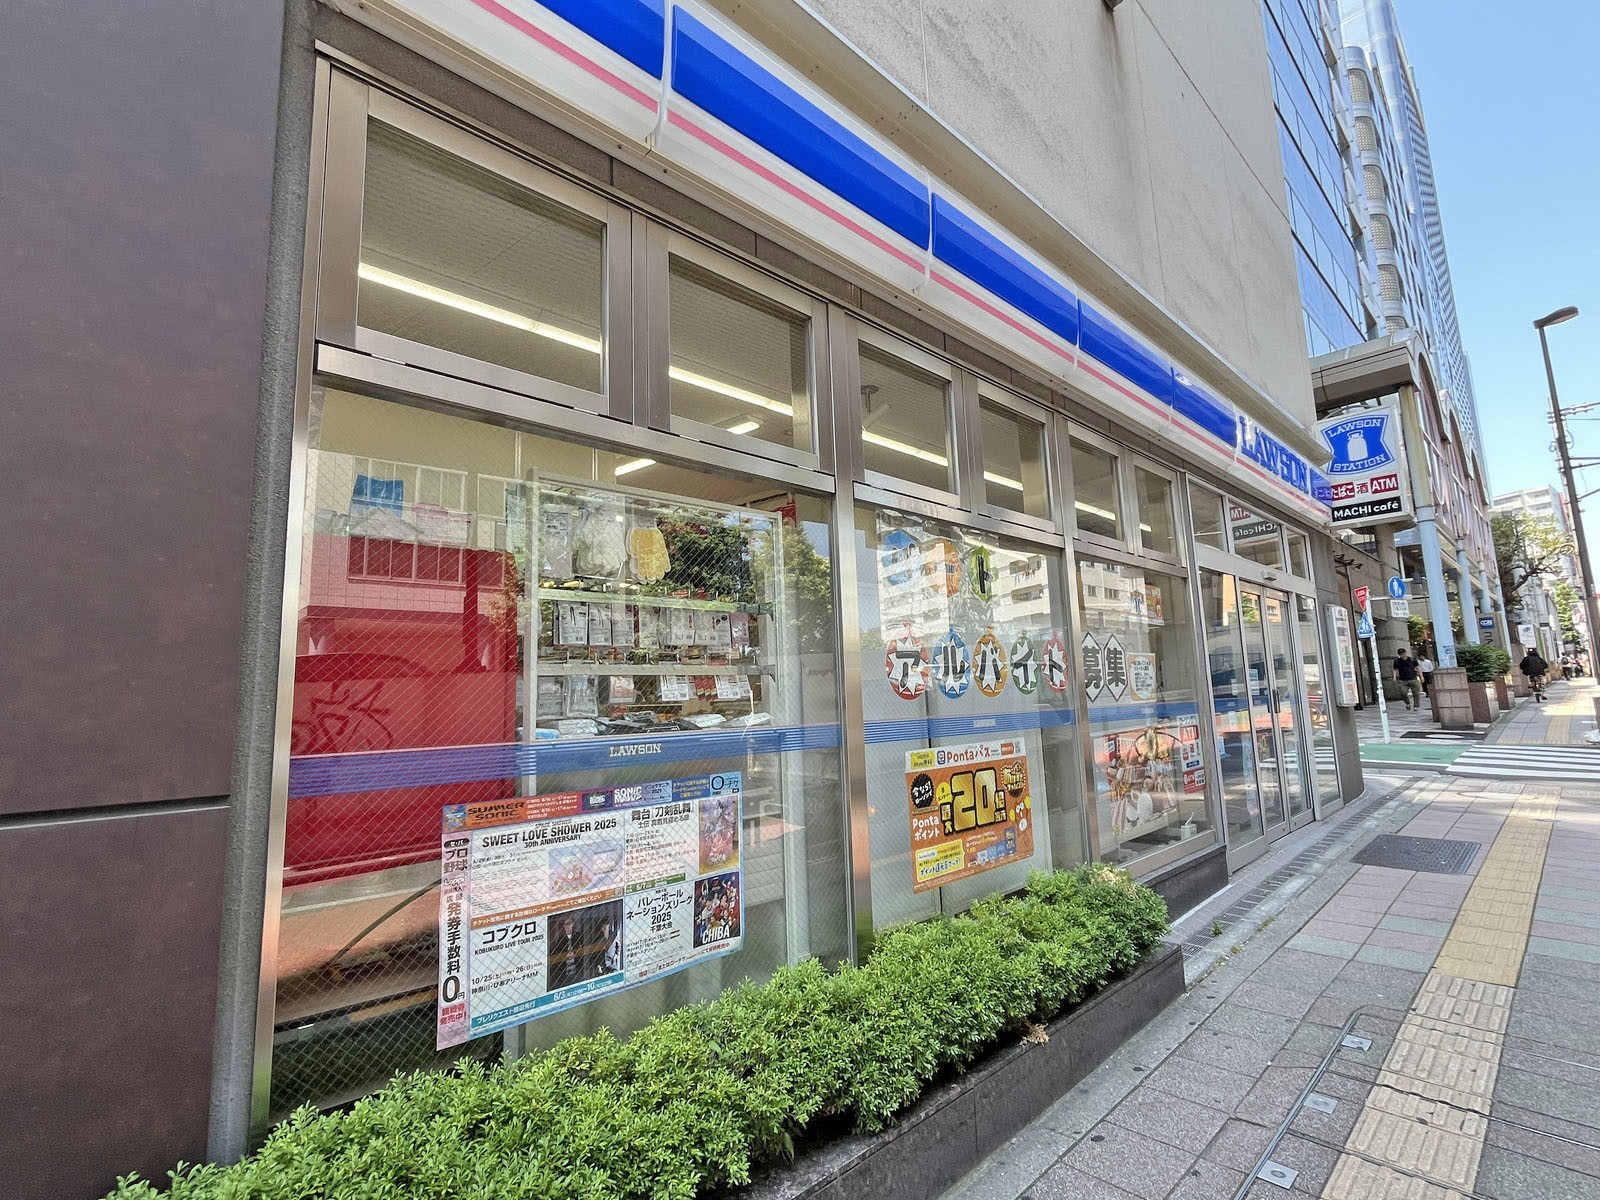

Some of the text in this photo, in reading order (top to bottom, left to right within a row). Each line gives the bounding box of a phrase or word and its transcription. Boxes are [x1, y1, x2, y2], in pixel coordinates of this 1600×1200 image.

[1328, 419, 1382, 437] LAWSON
[1239, 415, 1309, 495] LAWSON
[1334, 454, 1387, 471] STATION
[1371, 477, 1398, 492] ATM
[1334, 500, 1399, 518] MACHI café
[895, 649, 1065, 689] アルバイト
[1083, 646, 1126, 690] 募集
[609, 743, 662, 757] LAWSON
[946, 745, 991, 763] Pontaパス
[614, 787, 642, 797] SONIC
[912, 781, 931, 797] 今なら!
[467, 802, 525, 815] SUMMER
[951, 768, 997, 833] 20
[475, 810, 519, 821] SONIC
[912, 815, 940, 830] Ponta
[482, 818, 617, 848] SWEET LOVE SHOWER 2025
[524, 834, 582, 849] 30th ANNIVERSARY
[914, 827, 940, 842] ポイント
[637, 889, 684, 908] バレーボール
[651, 911, 672, 926] 2025
[482, 921, 537, 945] コブクロ
[702, 925, 730, 944] CHIBA
[474, 945, 504, 955] KOBUKURO
[505, 941, 516, 949] LIVE
[517, 938, 531, 947] TOUR
